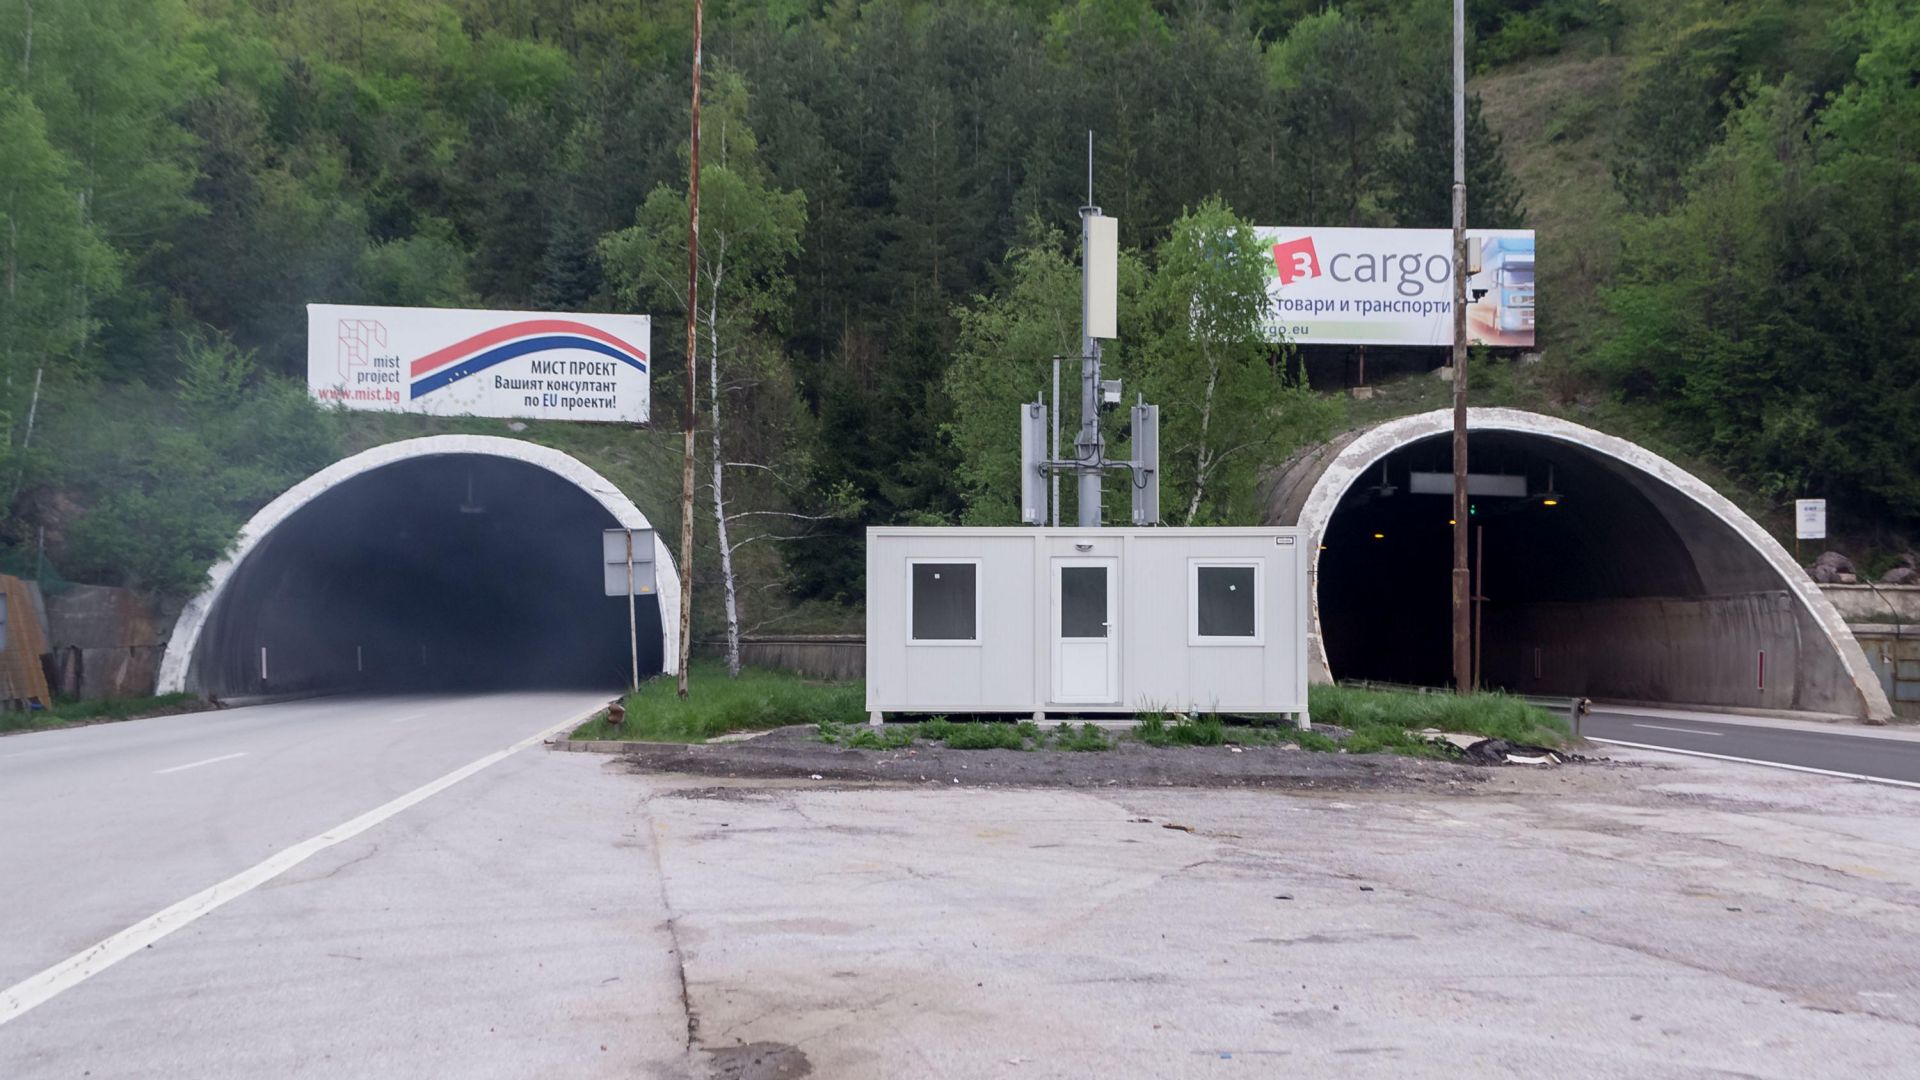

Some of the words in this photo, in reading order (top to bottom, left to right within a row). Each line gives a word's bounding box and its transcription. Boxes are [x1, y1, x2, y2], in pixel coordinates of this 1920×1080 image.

[1291, 251, 1313, 281] 3
[1329, 252, 1451, 296] cargo
[1277, 299, 1335, 316] товари
[1340, 300, 1350, 312] и
[1354, 299, 1451, 317] транспорти
[373, 355, 400, 368] mist
[531, 360, 566, 375] МИСТ
[569, 361, 617, 376] ПРОЕКТ
[357, 370, 400, 384] project
[494, 375, 543, 391] Вашият
[546, 380, 617, 395] консултант
[318, 386, 400, 404] www.mist.bg
[524, 395, 539, 407] по
[543, 393, 558, 407] EU
[561, 395, 616, 411] проекти!
